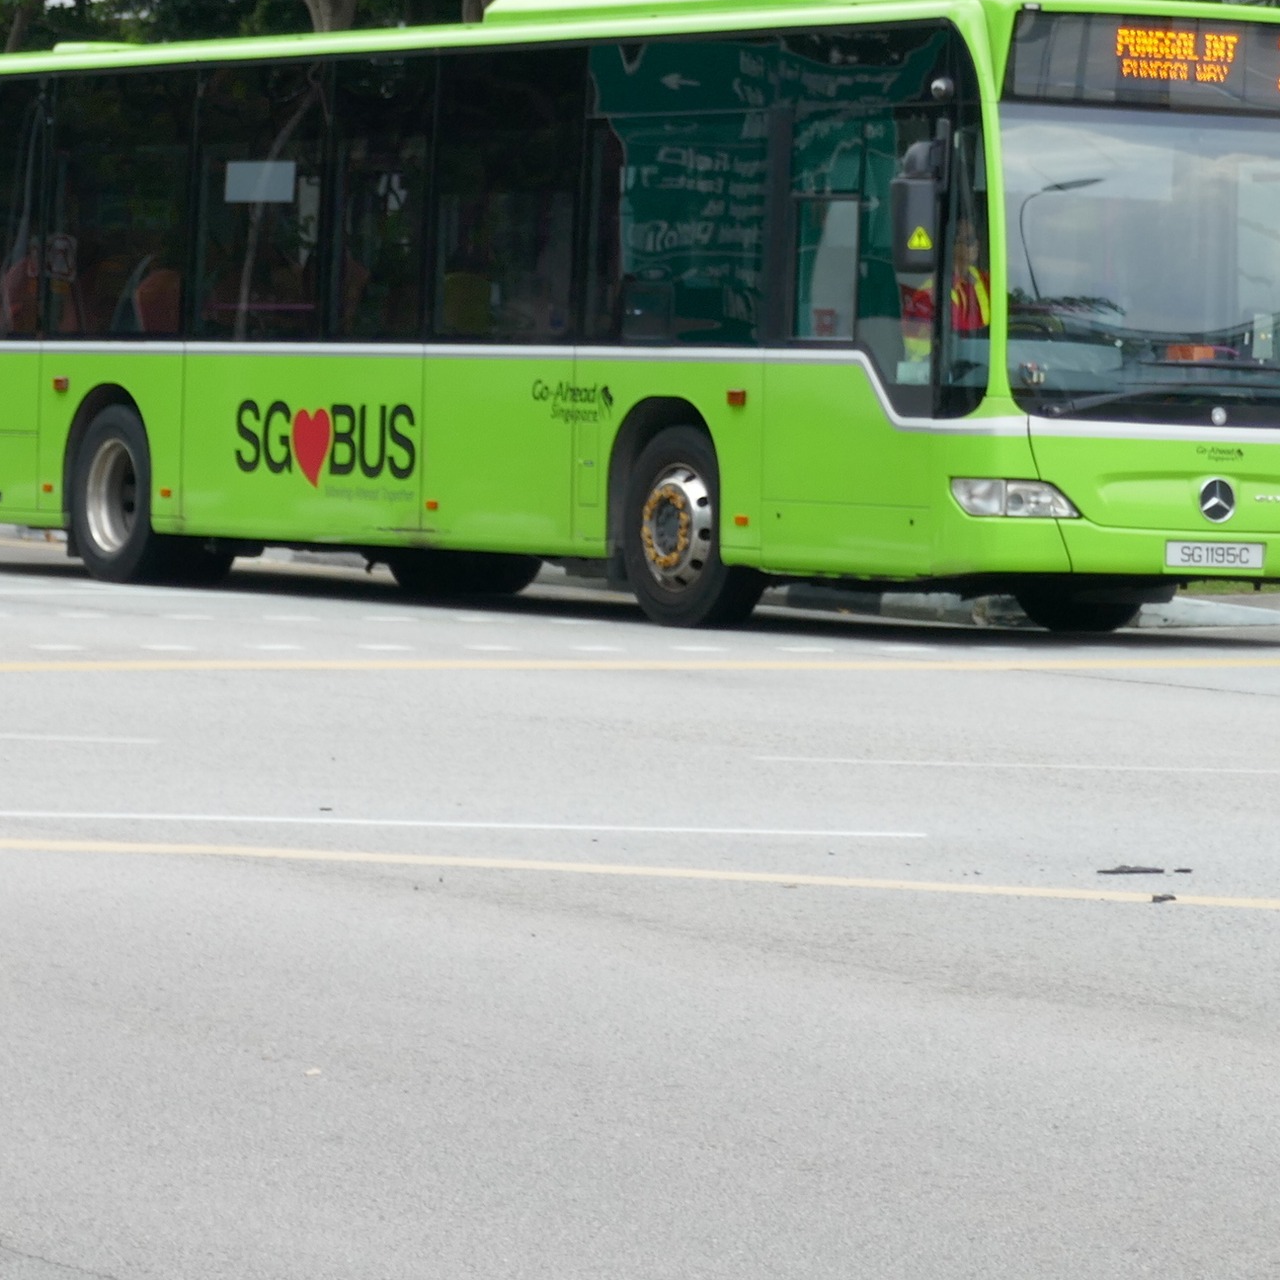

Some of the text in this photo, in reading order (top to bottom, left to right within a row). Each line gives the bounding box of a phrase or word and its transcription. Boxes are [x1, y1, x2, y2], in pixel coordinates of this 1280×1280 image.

[1117, 28, 1238, 62] PUNGGOL INT
[532, 379, 598, 403] Go-Ahead
[551, 404, 599, 424] Singapore
[235, 399, 416, 479] SG BUS
[1180, 546, 1250, 565] SG1195C
